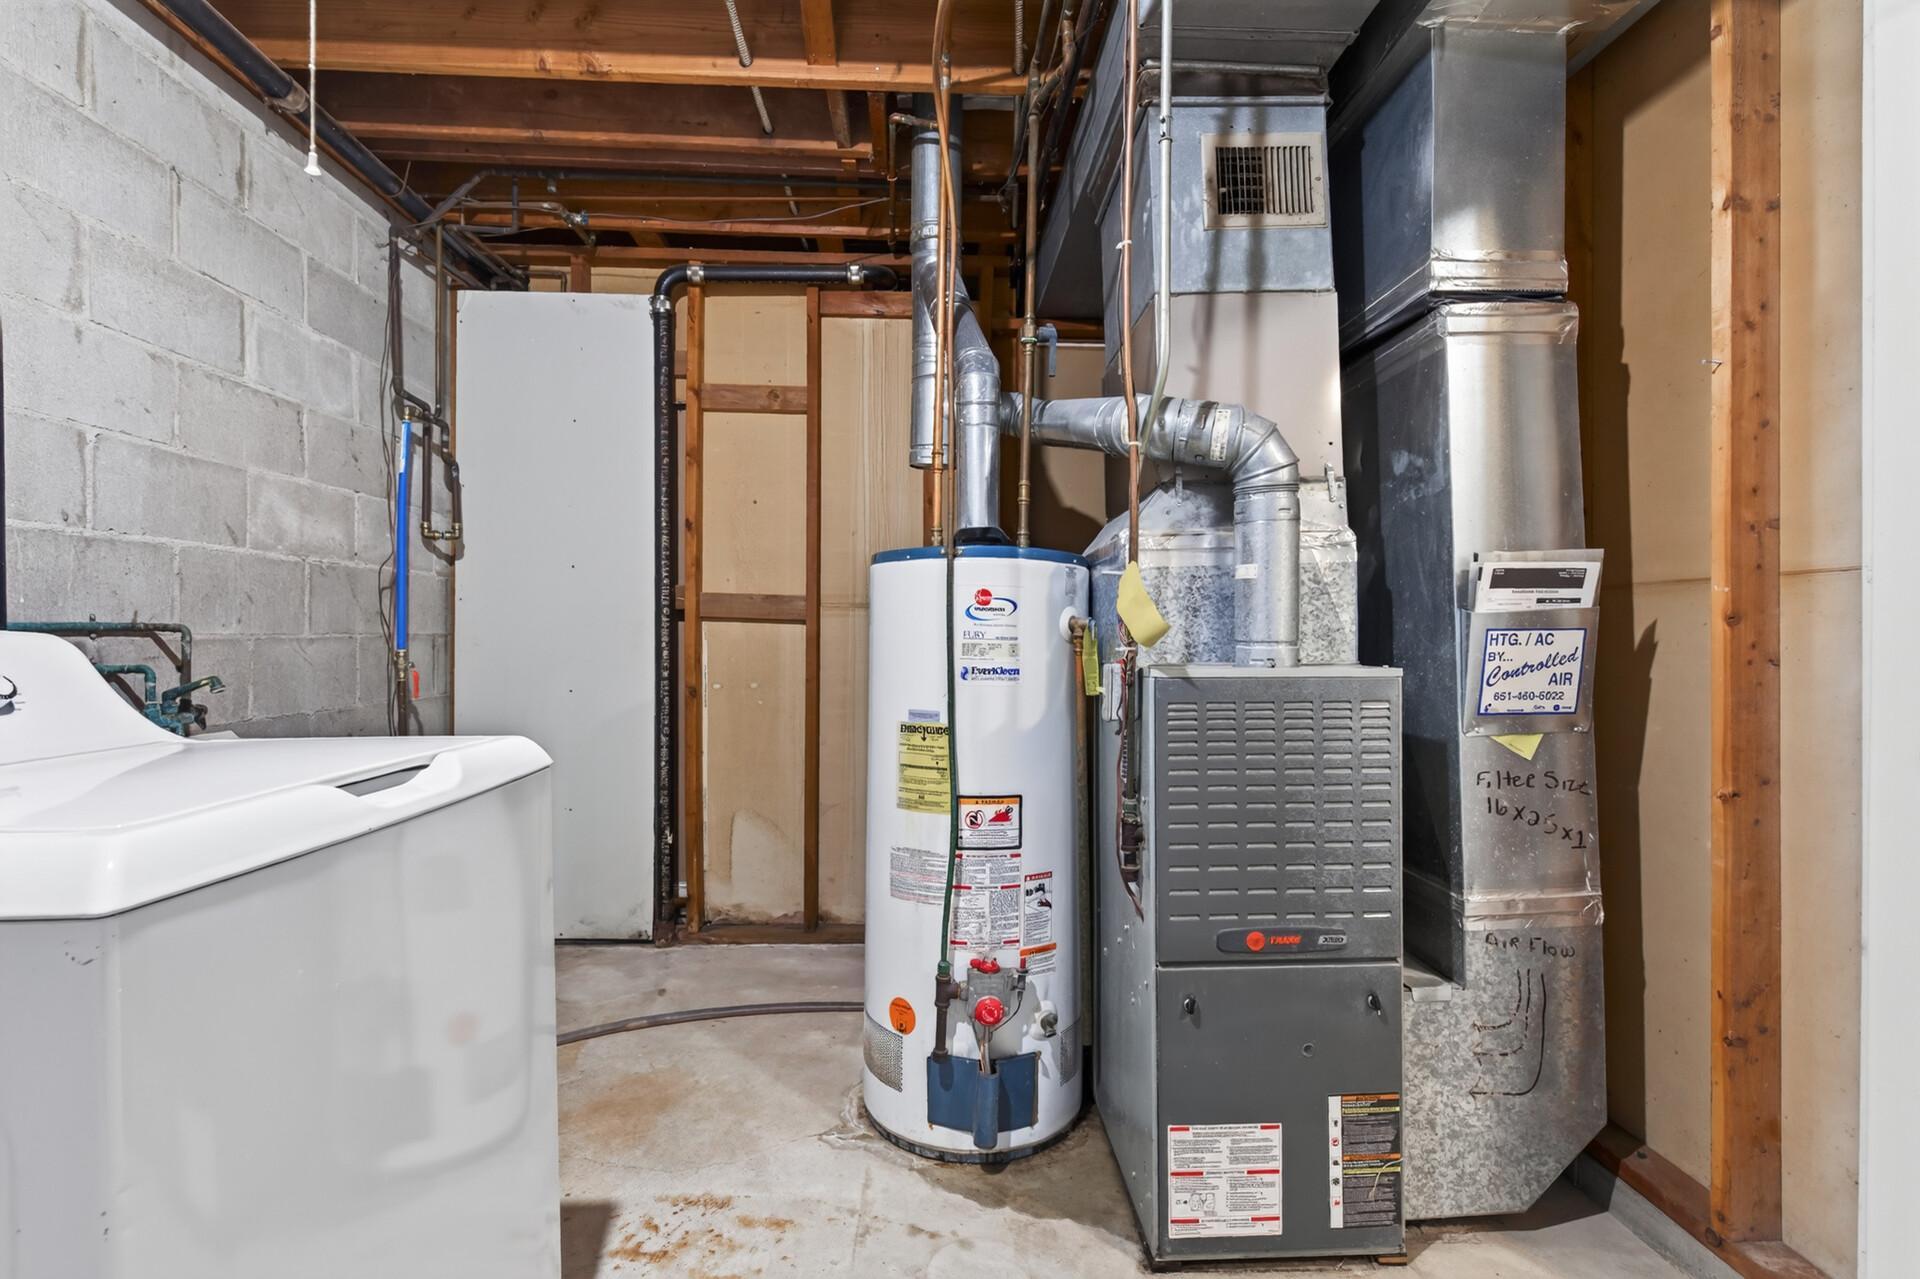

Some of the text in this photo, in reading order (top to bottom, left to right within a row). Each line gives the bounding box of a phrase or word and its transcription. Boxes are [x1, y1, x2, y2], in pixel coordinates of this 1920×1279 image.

[1489, 633, 1522, 646] HTG.
[1534, 633, 1555, 646] AC
[1486, 646, 1579, 687] Controlled
[1548, 672, 1573, 686] AIR
